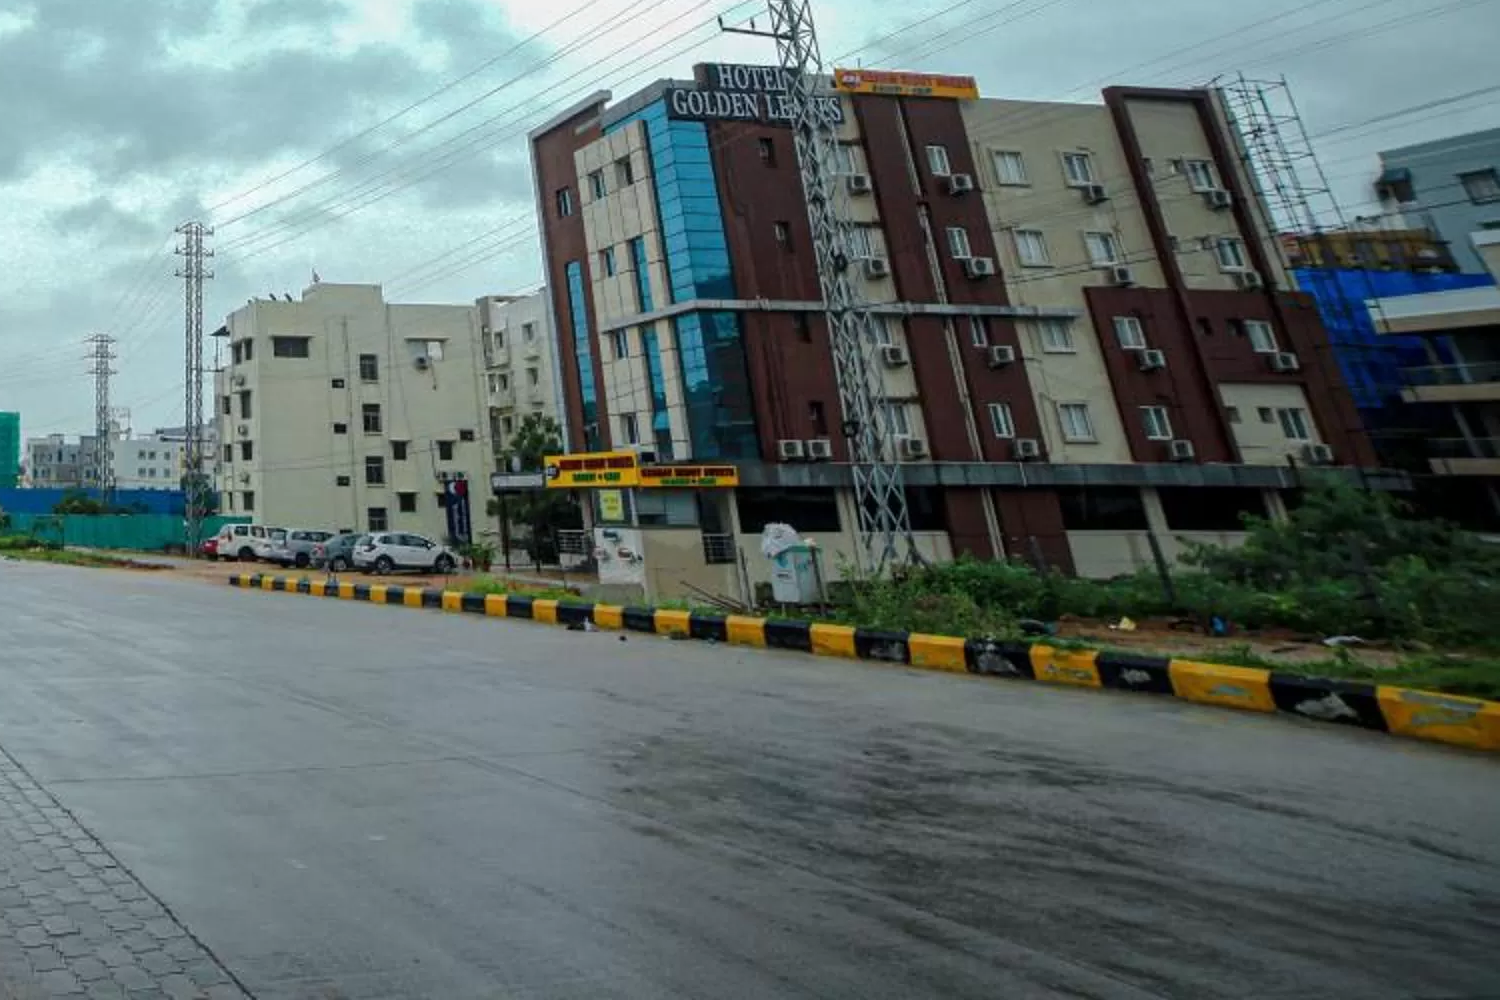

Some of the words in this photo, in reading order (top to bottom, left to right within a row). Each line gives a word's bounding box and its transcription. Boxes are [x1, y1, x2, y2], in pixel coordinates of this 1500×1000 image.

[719, 65, 786, 91] HOTEL
[672, 89, 760, 118] GOLDEN
[764, 93, 842, 121] LEAES
